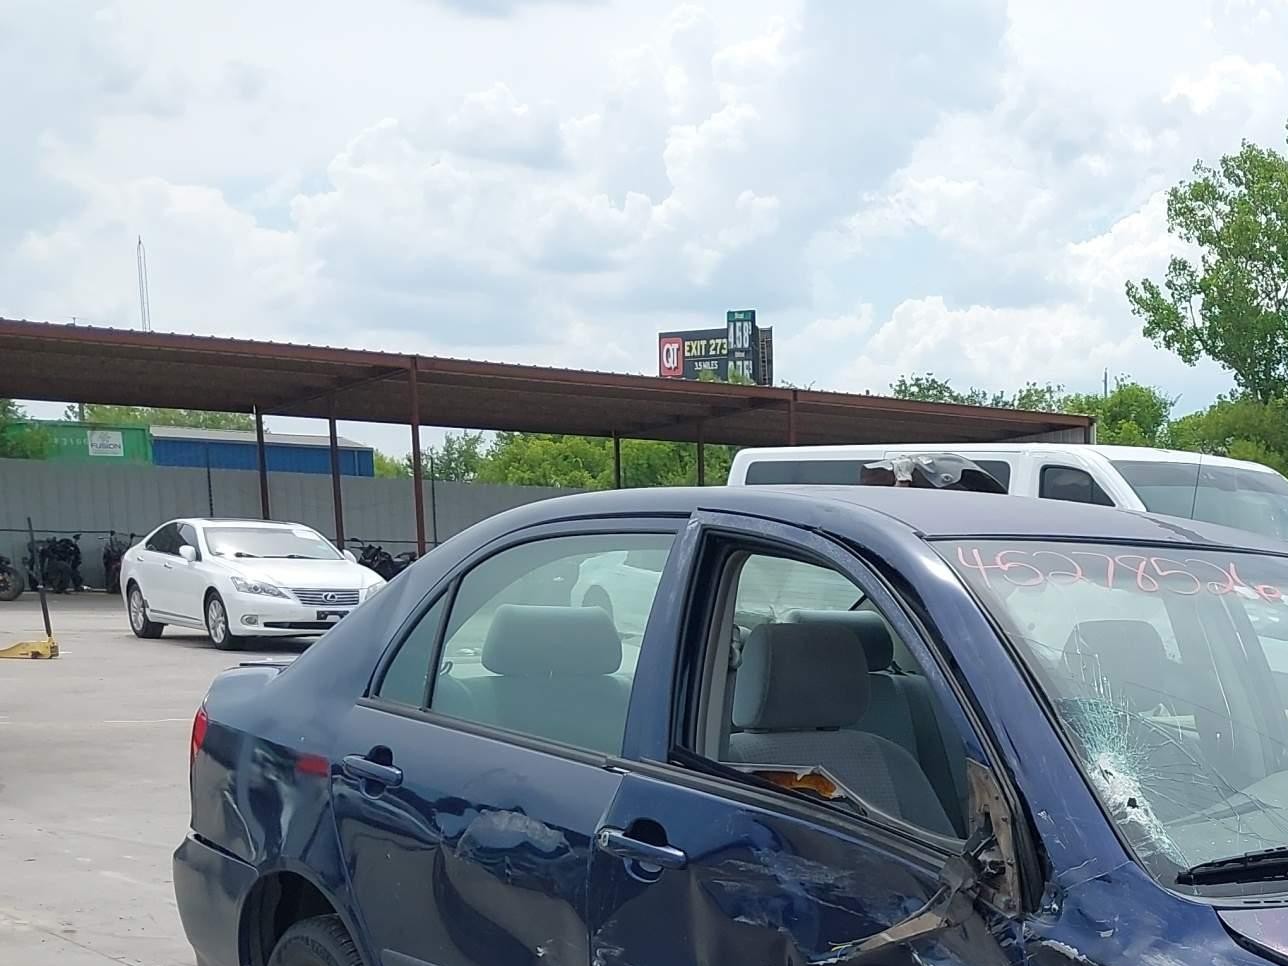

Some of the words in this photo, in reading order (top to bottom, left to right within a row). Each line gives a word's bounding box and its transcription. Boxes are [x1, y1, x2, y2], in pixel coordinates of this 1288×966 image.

[663, 343, 679, 371] QT
[684, 340, 707, 357] EXIT
[709, 338, 728, 355] 273
